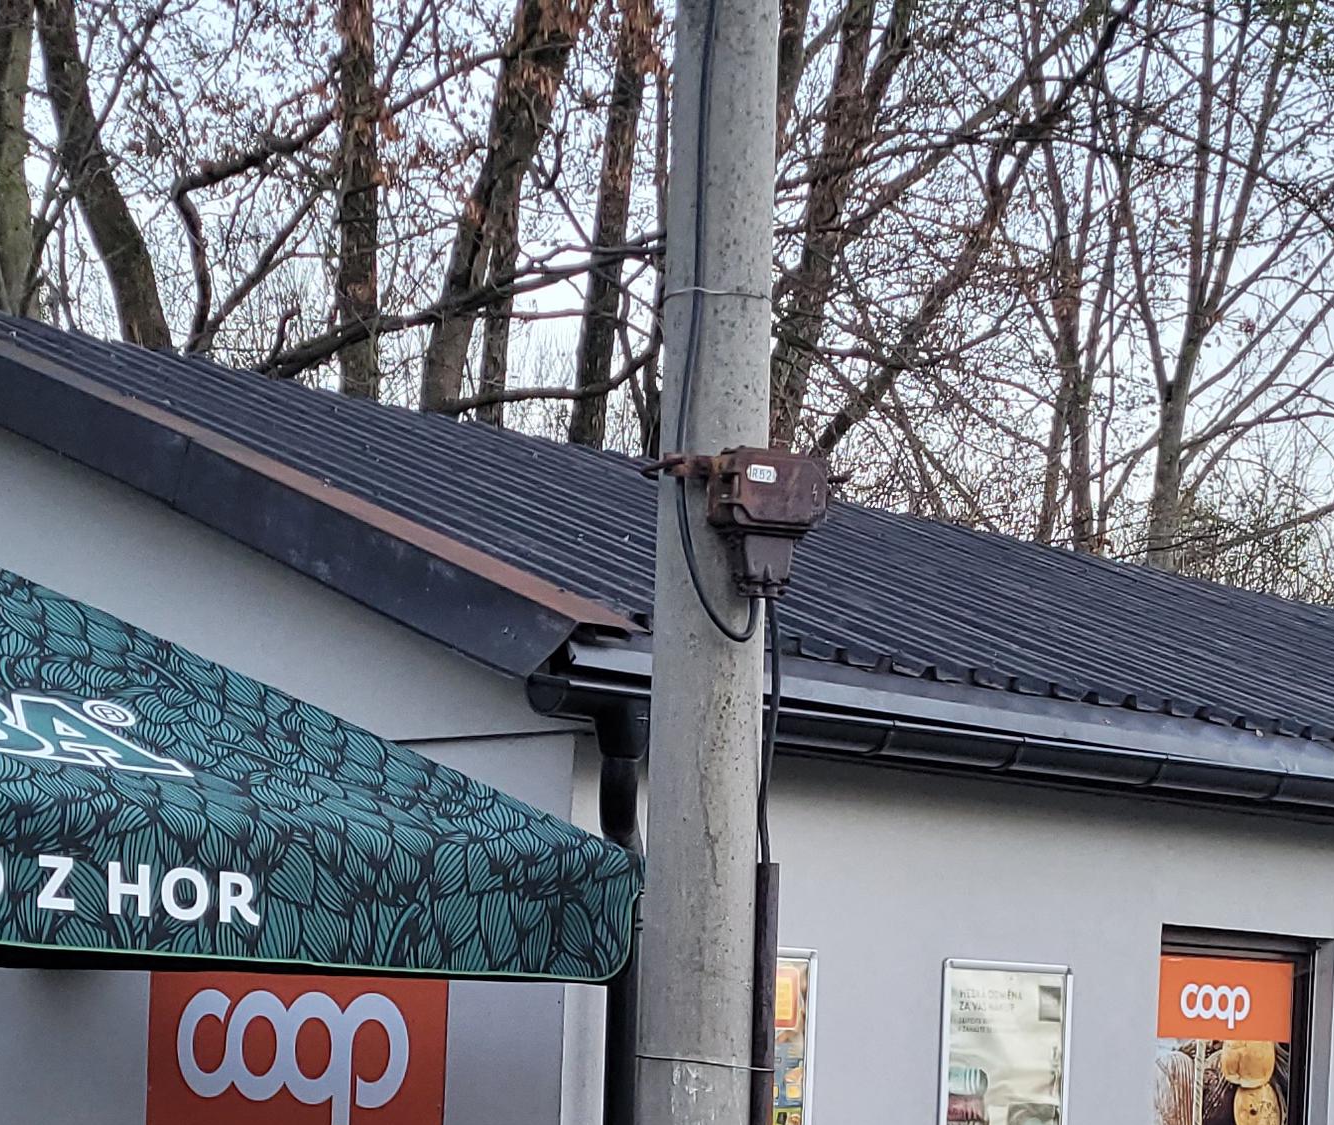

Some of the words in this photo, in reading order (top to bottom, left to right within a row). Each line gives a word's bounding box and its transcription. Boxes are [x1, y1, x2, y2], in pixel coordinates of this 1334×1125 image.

[37, 854, 76, 911] Z
[108, 863, 261, 927] HOR
[1180, 983, 1251, 1029] coop
